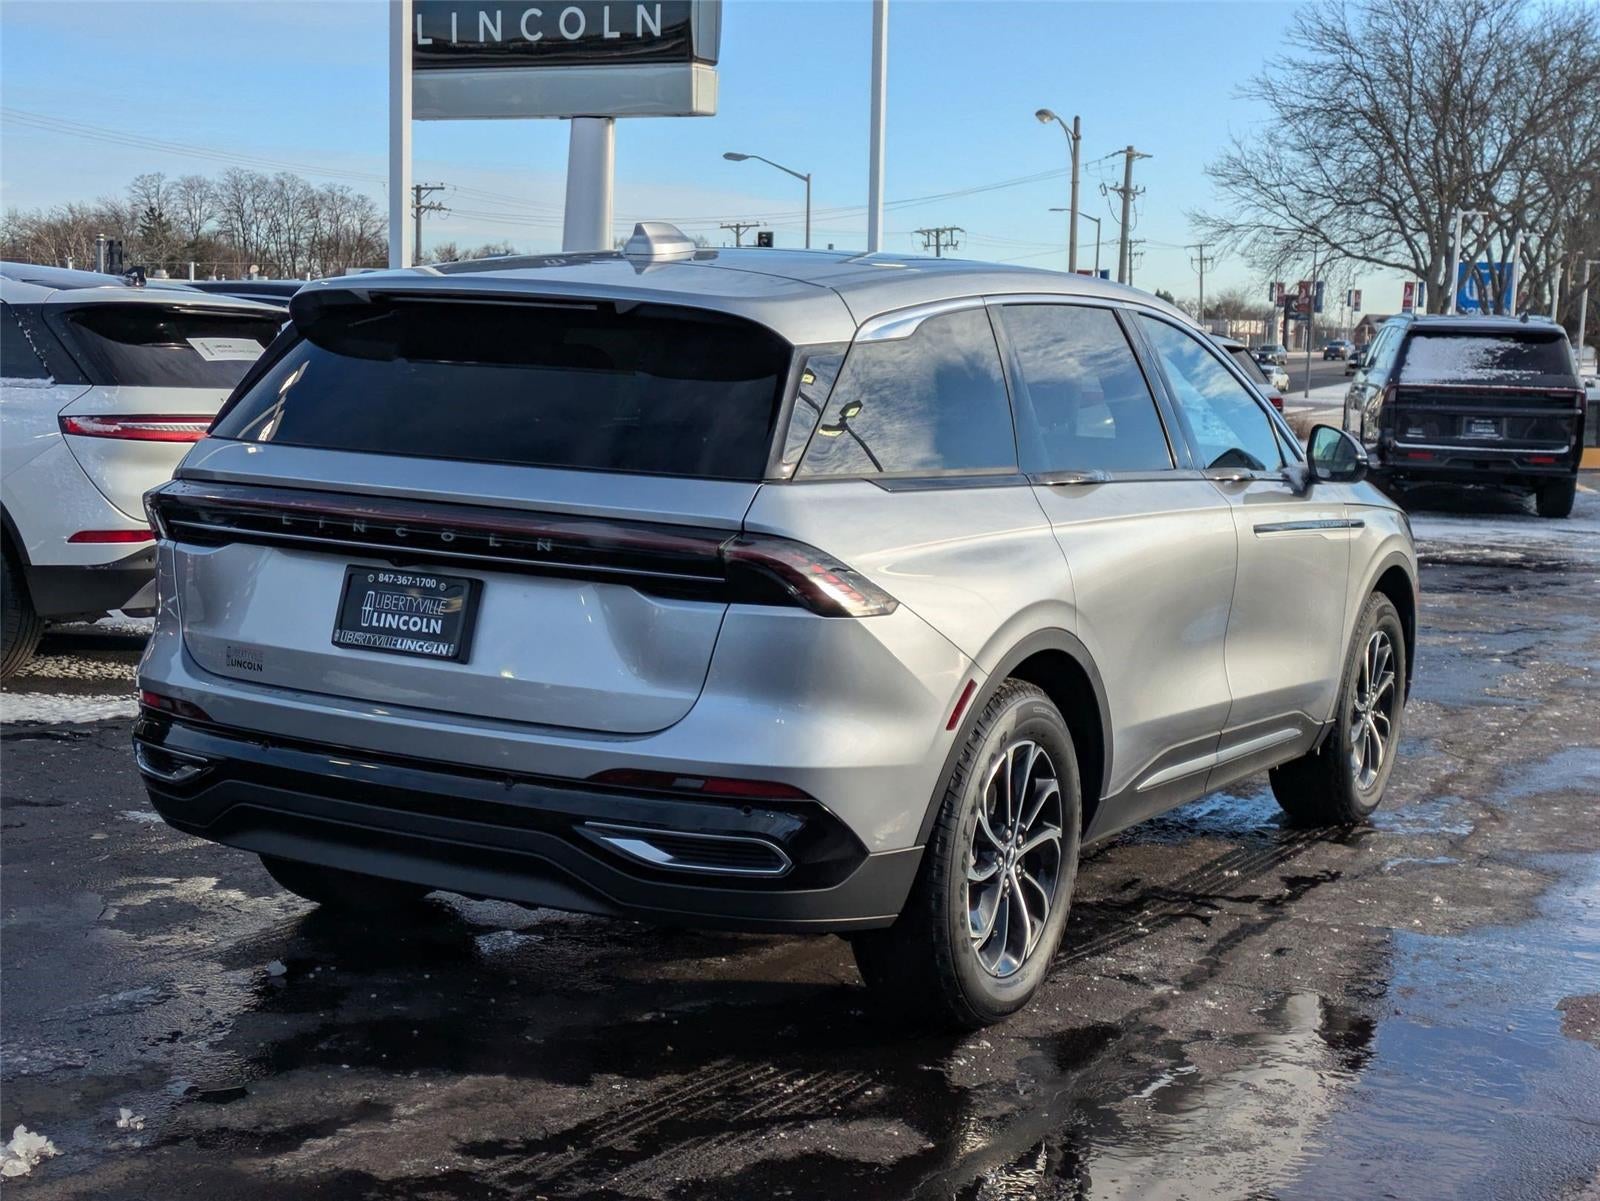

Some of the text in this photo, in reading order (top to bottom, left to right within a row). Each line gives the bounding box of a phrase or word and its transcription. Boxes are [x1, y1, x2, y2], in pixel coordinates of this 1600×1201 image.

[416, 3, 662, 45] LINCOLN
[282, 514, 551, 552] LINCOLN
[378, 573, 437, 588] 847-367-1700
[375, 593, 447, 616] LIBERTYVILLE
[371, 612, 442, 634] LINCOLN
[231, 658, 263, 672] LINCOLN
